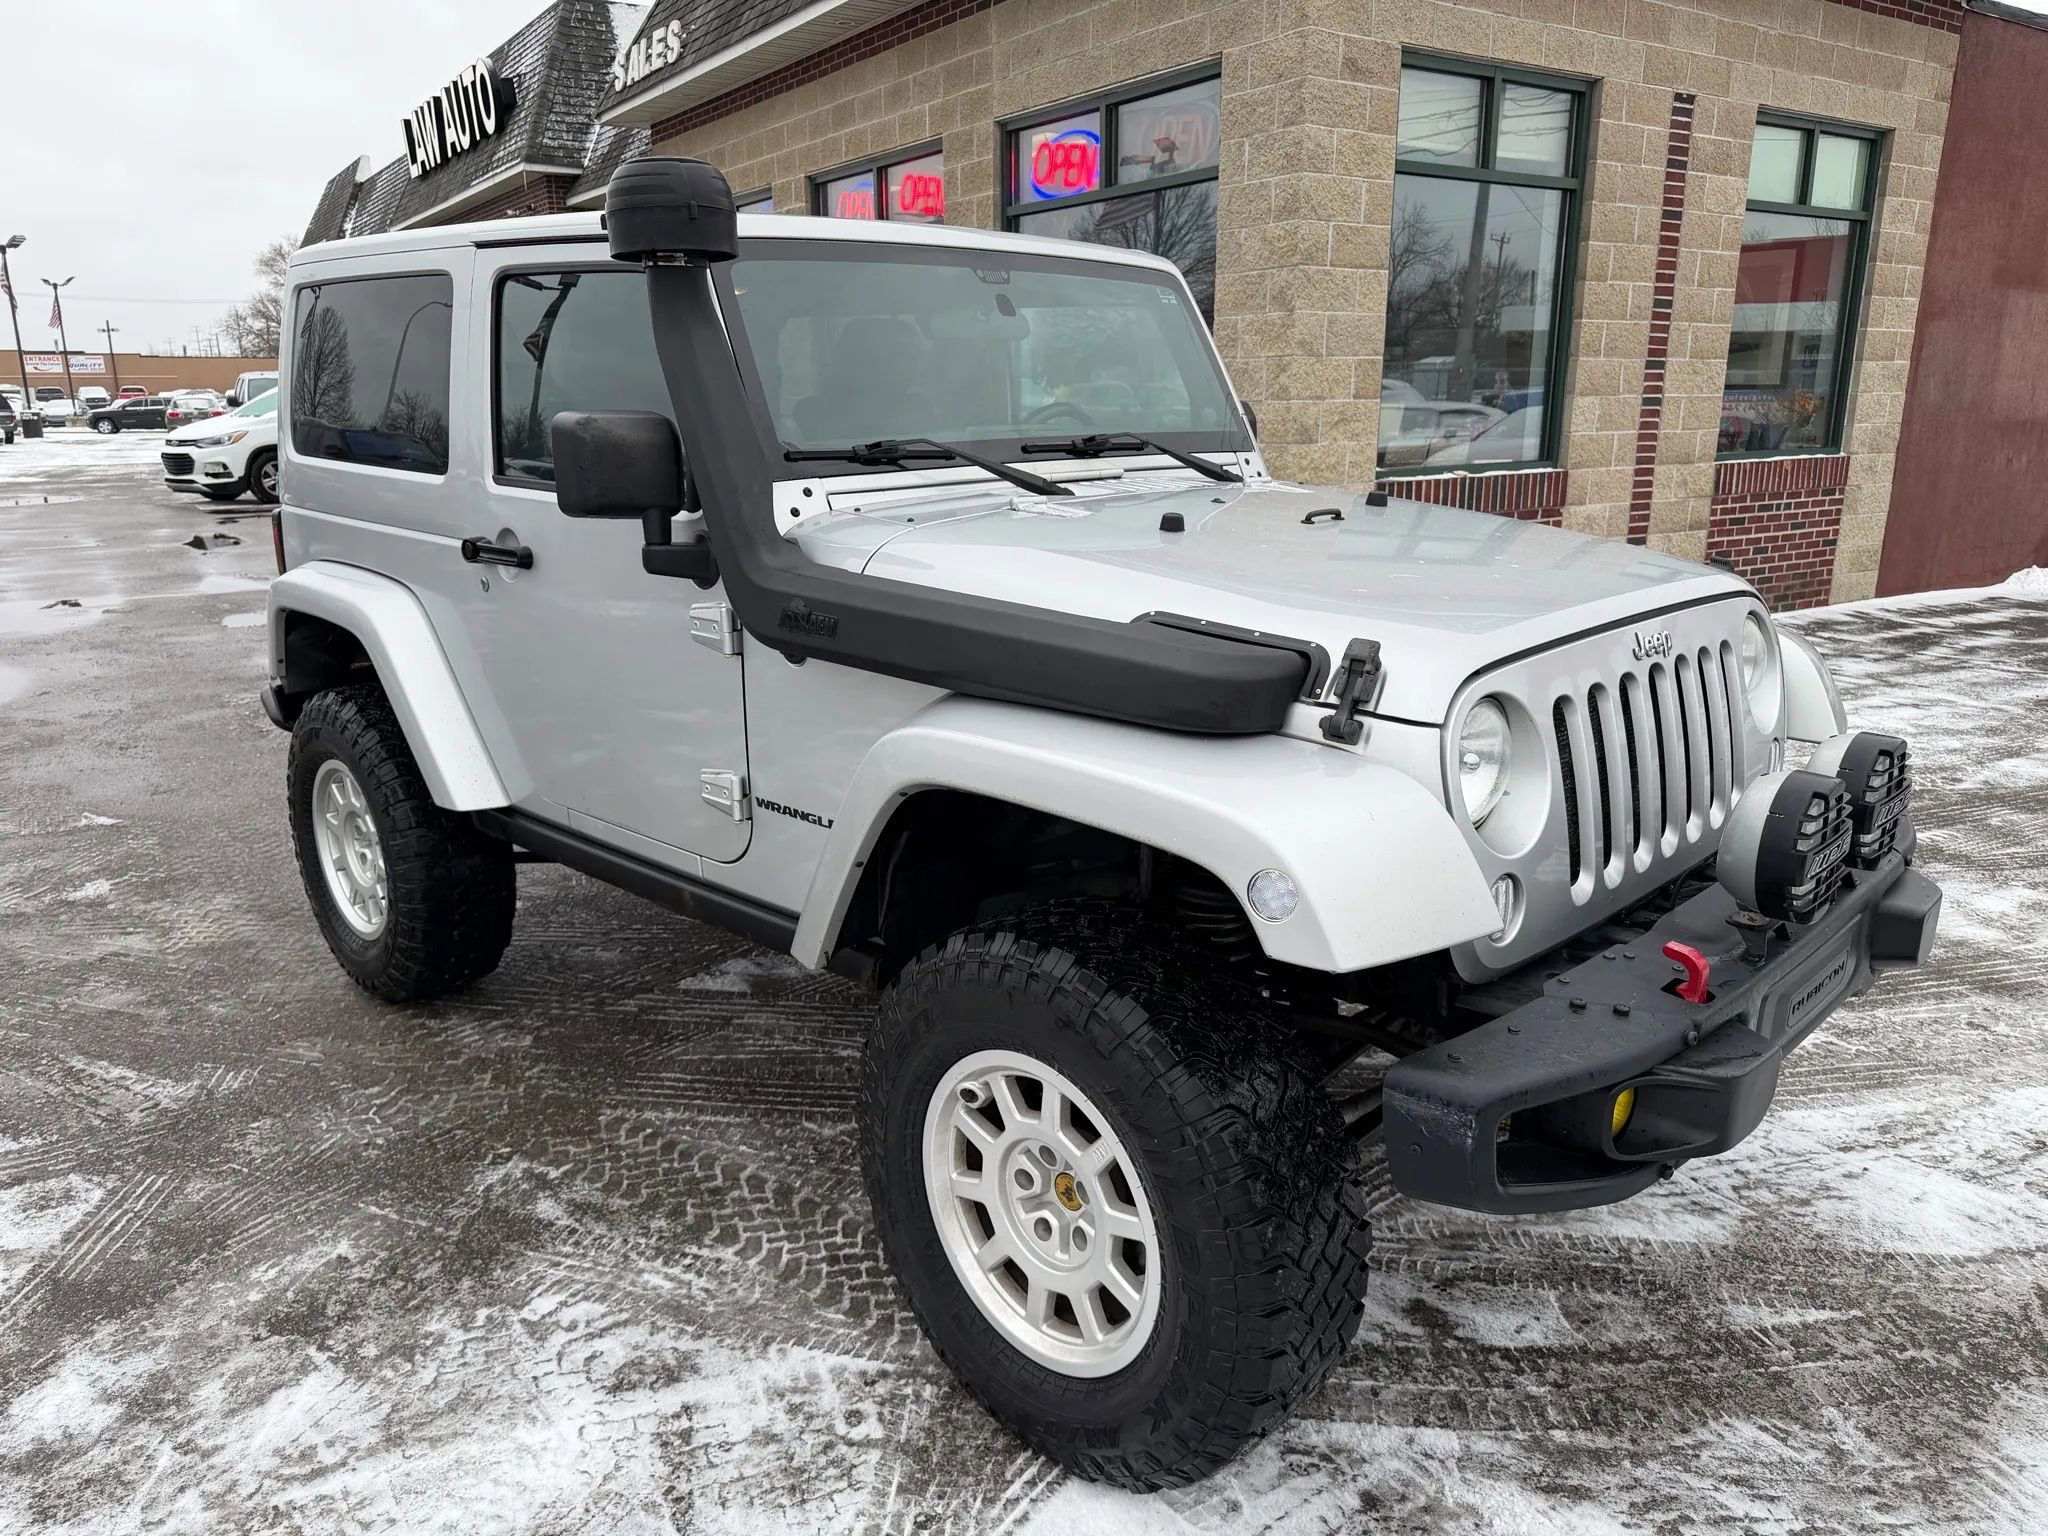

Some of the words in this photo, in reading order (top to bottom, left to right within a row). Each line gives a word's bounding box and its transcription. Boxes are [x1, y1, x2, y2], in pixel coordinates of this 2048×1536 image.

[613, 19, 683, 93] SALES
[400, 97, 442, 180] LAW
[439, 57, 497, 158] AUTO
[1032, 141, 1099, 190] OPEN
[1632, 629, 1673, 661] Jeep
[1789, 958, 1847, 1017] RUBICON
